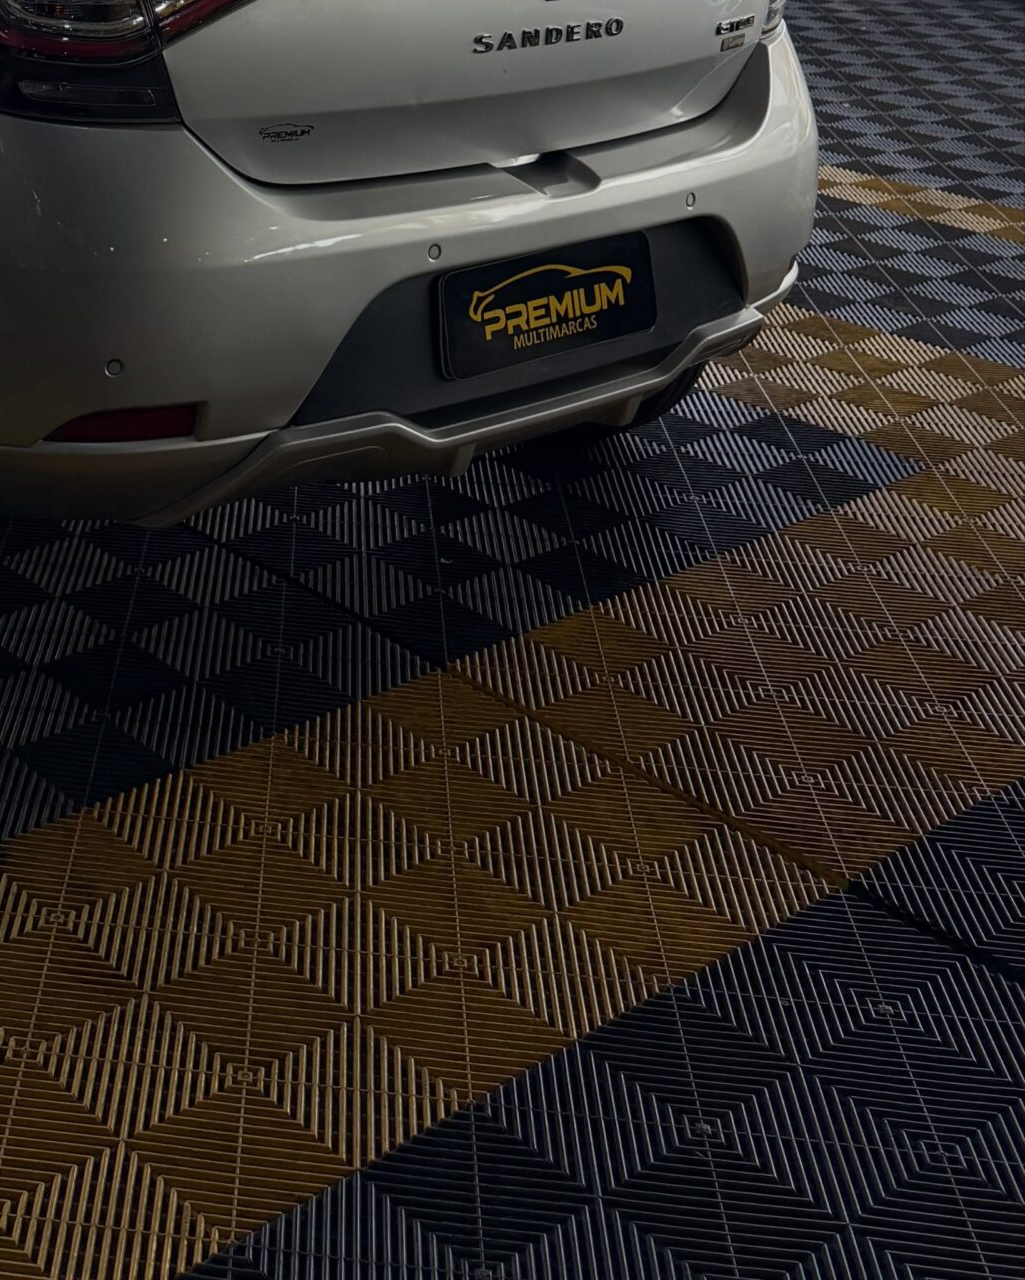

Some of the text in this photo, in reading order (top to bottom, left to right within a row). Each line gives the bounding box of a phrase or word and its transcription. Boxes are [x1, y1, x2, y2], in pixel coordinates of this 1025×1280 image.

[472, 17, 624, 54] SANDERO
[262, 129, 311, 142] PREMIUM
[483, 278, 625, 341] PREMIUM
[513, 314, 598, 350] MULTIMARCAS
